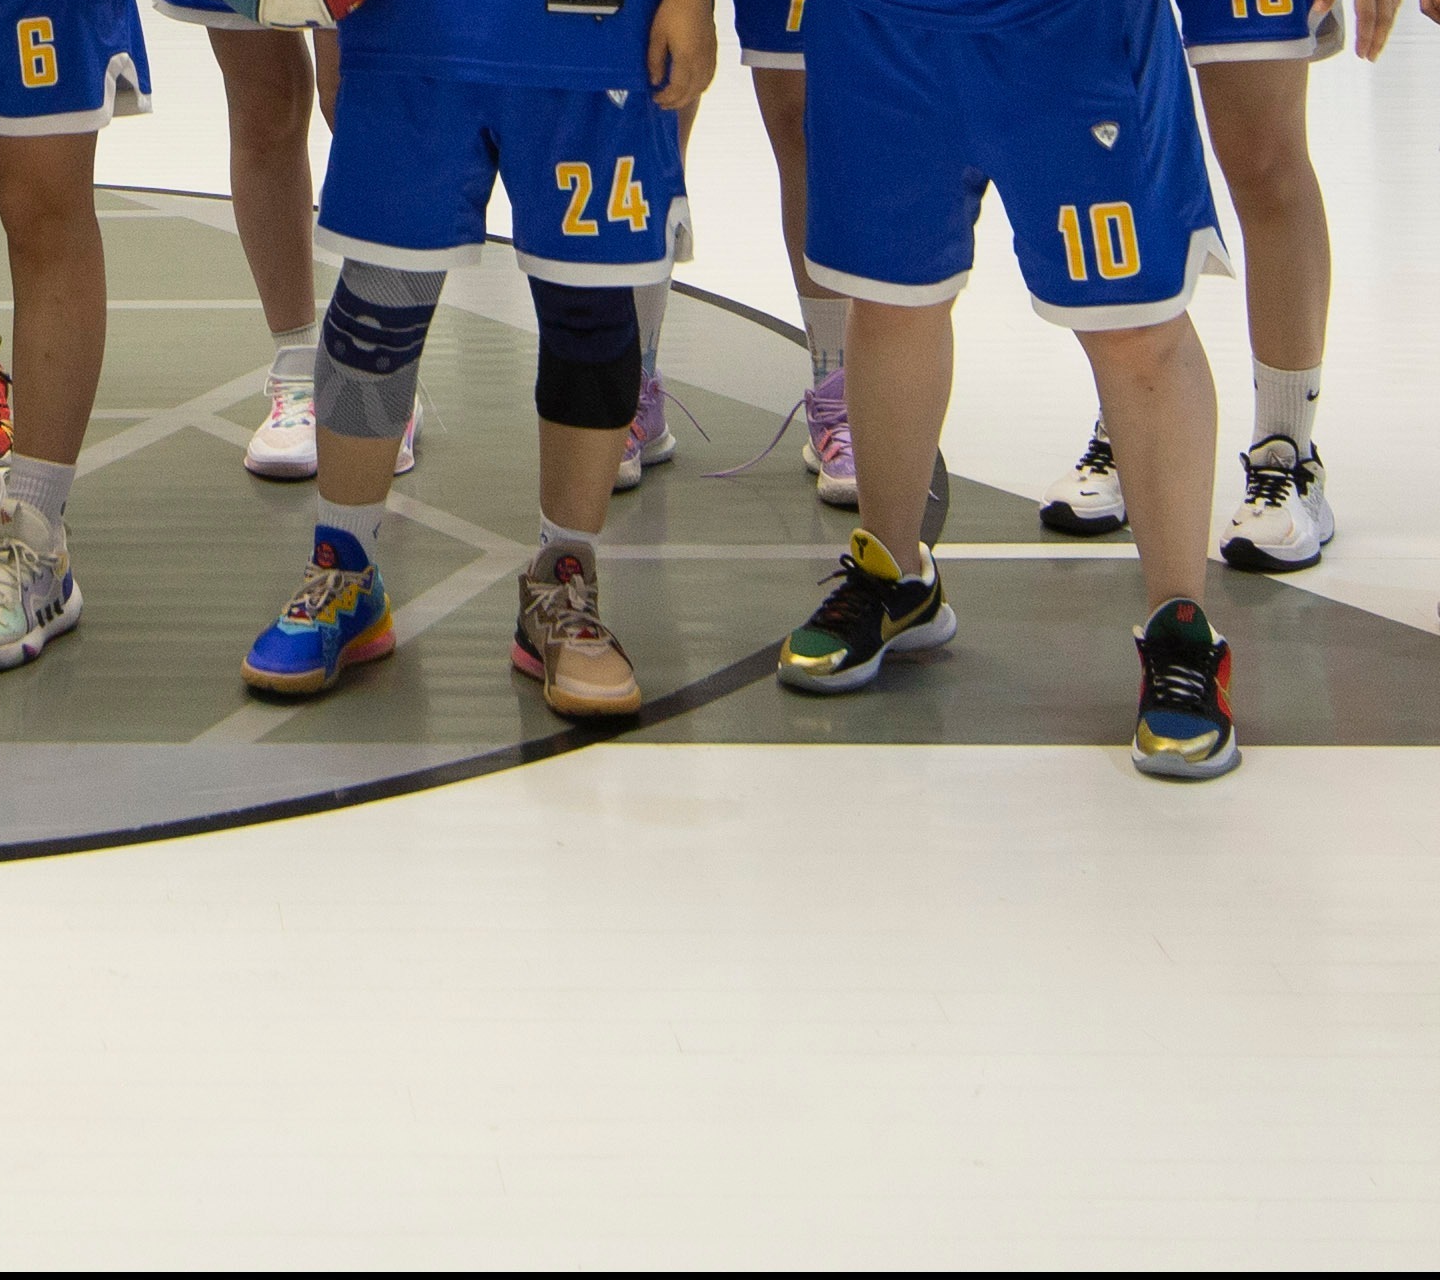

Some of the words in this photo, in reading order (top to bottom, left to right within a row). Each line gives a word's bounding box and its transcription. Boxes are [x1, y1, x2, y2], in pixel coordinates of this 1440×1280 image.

[15, 16, 59, 89] 6
[554, 157, 650, 237] 24
[1059, 201, 1142, 282] 10
